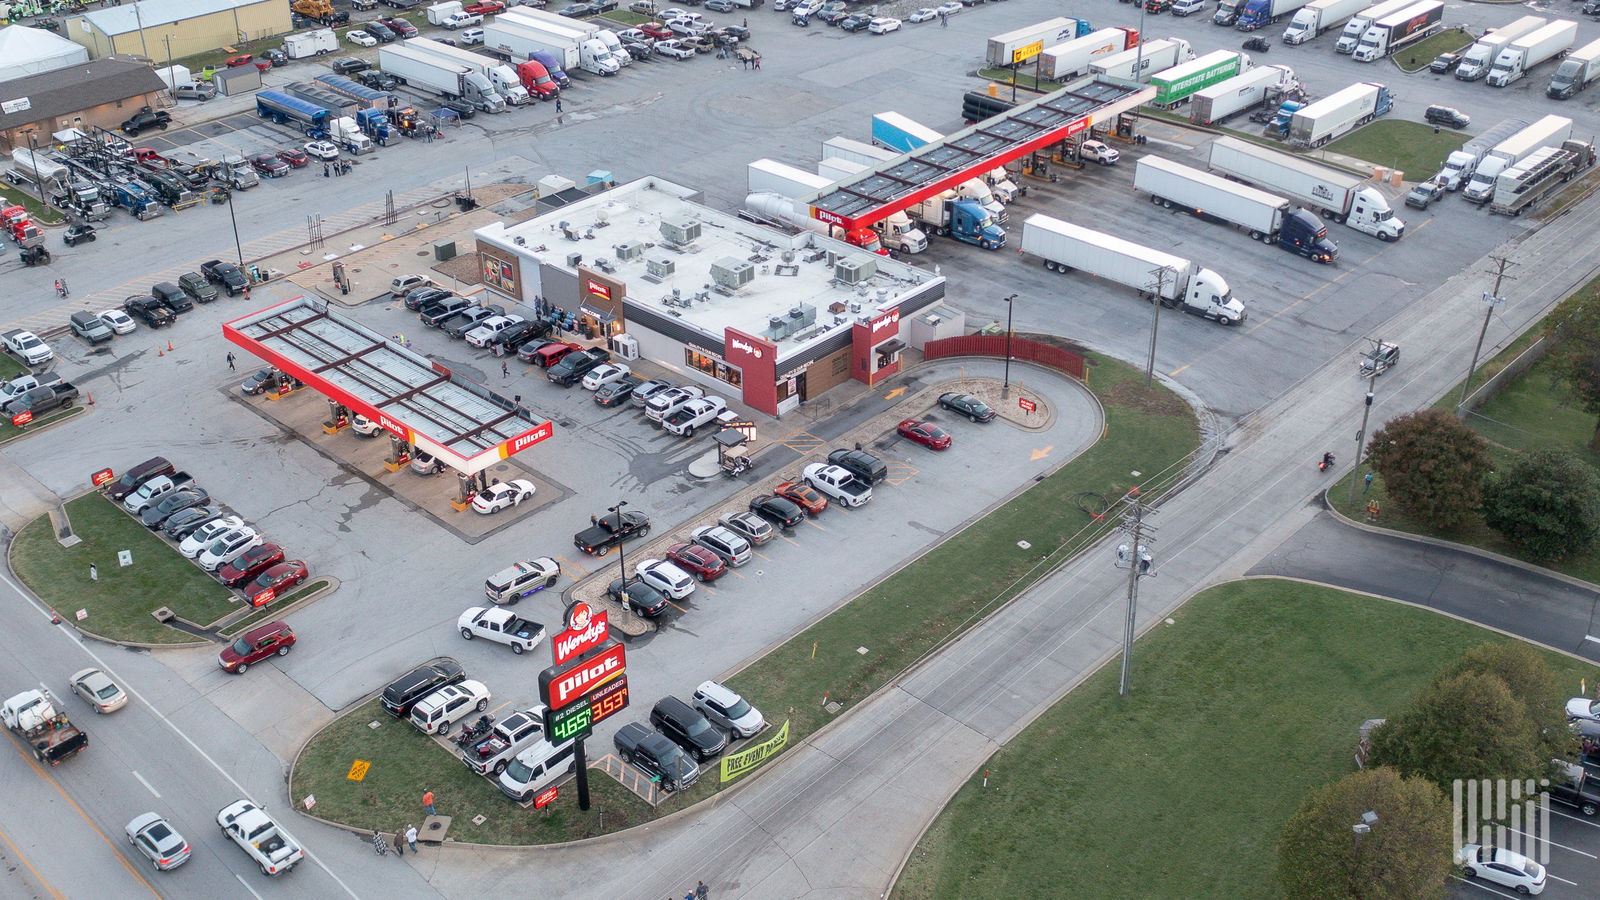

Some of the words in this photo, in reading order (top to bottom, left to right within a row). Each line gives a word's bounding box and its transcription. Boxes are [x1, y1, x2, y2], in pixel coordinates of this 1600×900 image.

[1170, 72, 1206, 93] INTERSTATE
[1205, 61, 1237, 79] BATTERIES
[557, 620, 606, 661] Wendy's
[592, 679, 625, 701] UNLEADED
[555, 712, 564, 722] #2
[566, 700, 589, 716] DIESEL
[727, 755, 743, 772] FREE
[743, 746, 764, 765] EVENT
